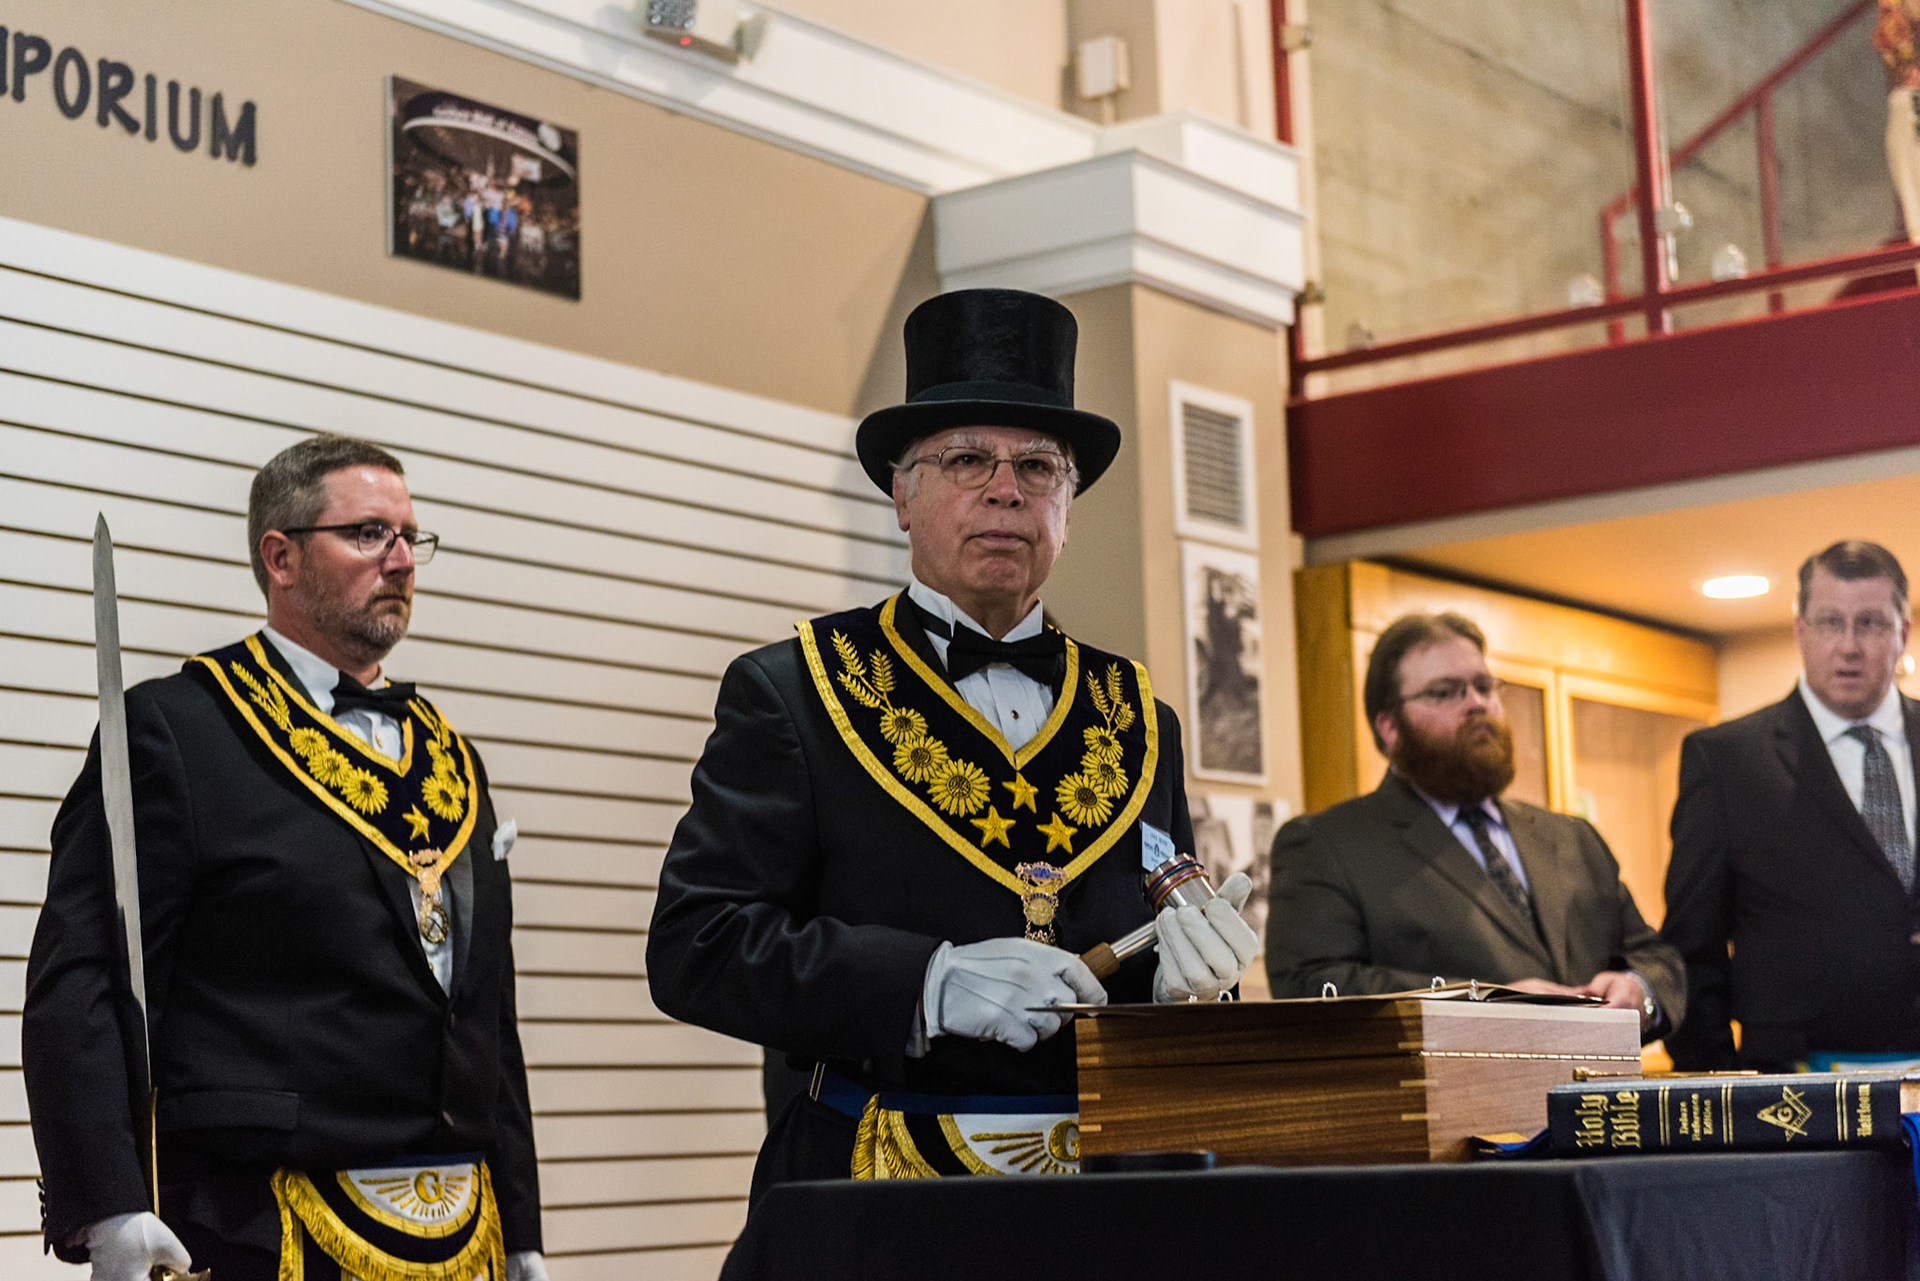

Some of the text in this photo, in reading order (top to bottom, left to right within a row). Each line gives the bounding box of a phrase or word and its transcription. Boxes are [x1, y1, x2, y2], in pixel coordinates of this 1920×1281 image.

[1574, 1093, 1609, 1147] Holy
[1610, 1090, 1642, 1149] Bible
[1679, 1101, 1689, 1134] Deluxe
[1691, 1093, 1701, 1141] Reference
[1702, 1099, 1713, 1135] Edition
[1777, 1107, 1793, 1122] G
[1856, 1084, 1872, 1137] Heirloom
[1048, 1120, 1080, 1162] G
[415, 1170, 443, 1204] G
